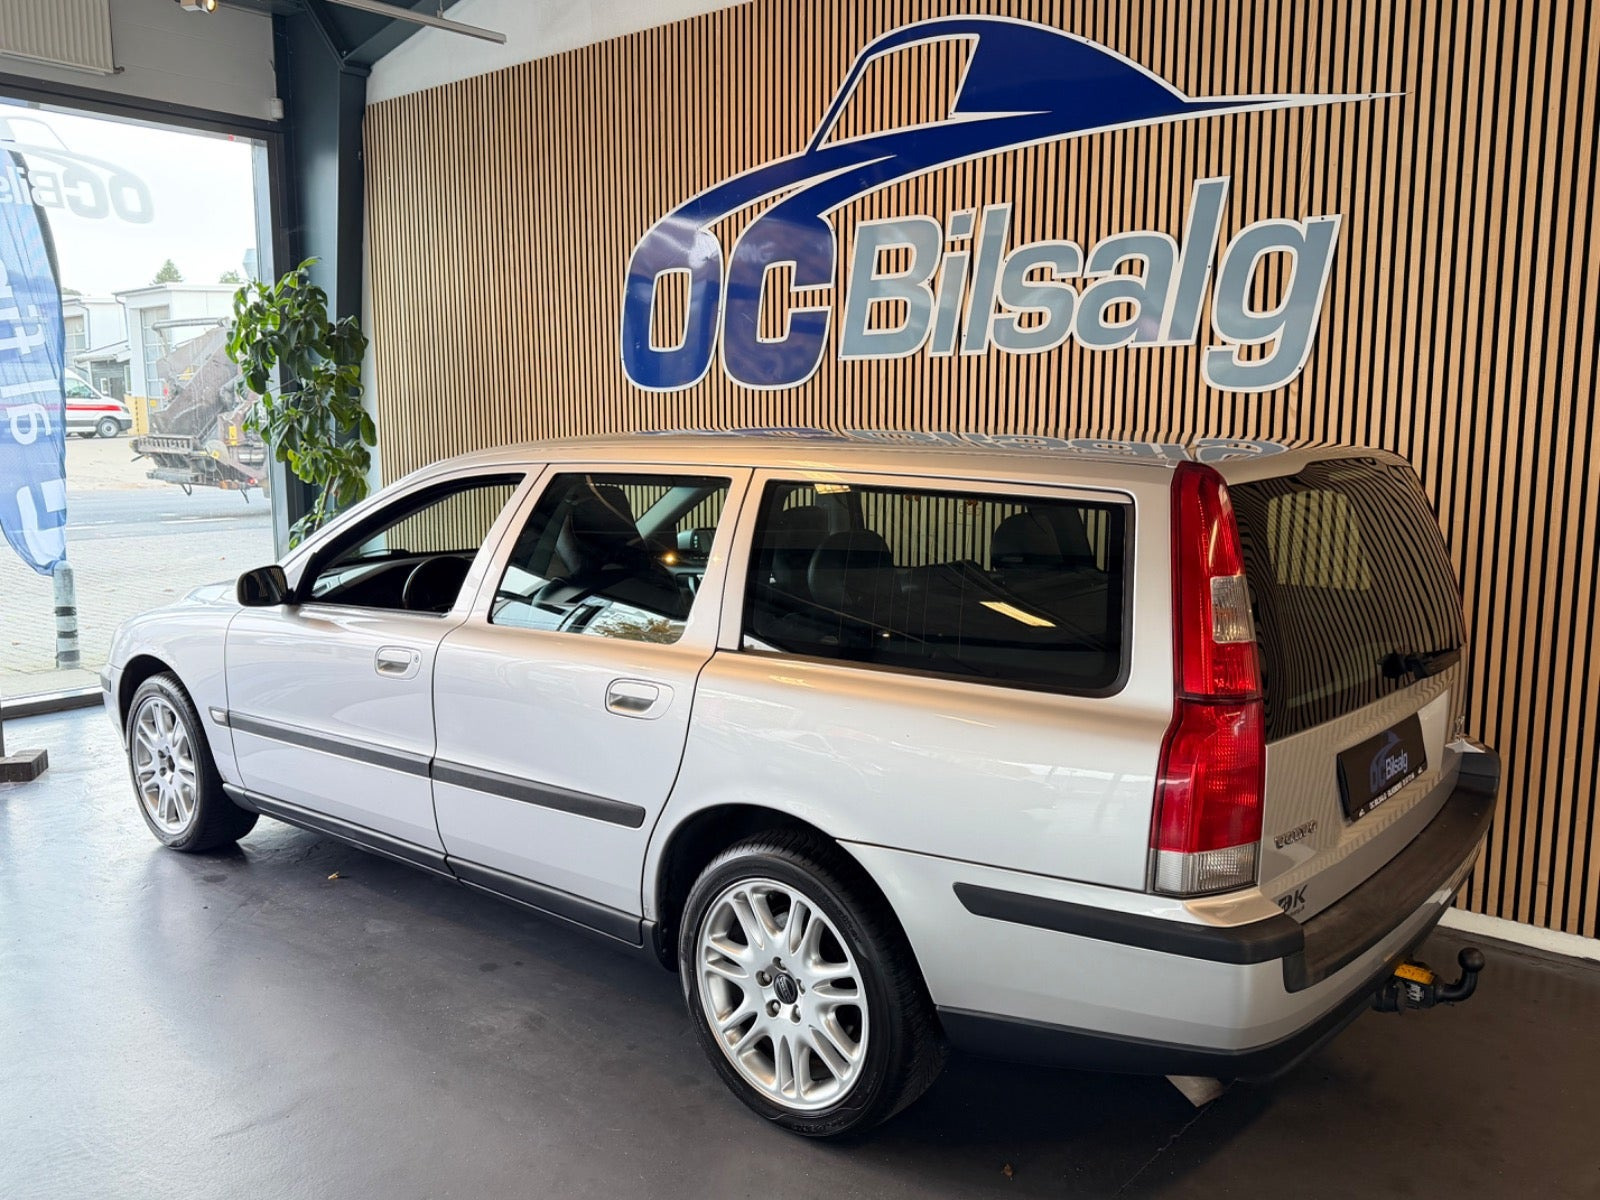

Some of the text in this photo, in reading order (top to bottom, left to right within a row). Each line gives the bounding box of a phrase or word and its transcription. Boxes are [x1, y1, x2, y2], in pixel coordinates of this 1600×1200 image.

[621, 177, 1341, 393] OC Bilsalg
[1385, 749, 1408, 779] Bilsalg
